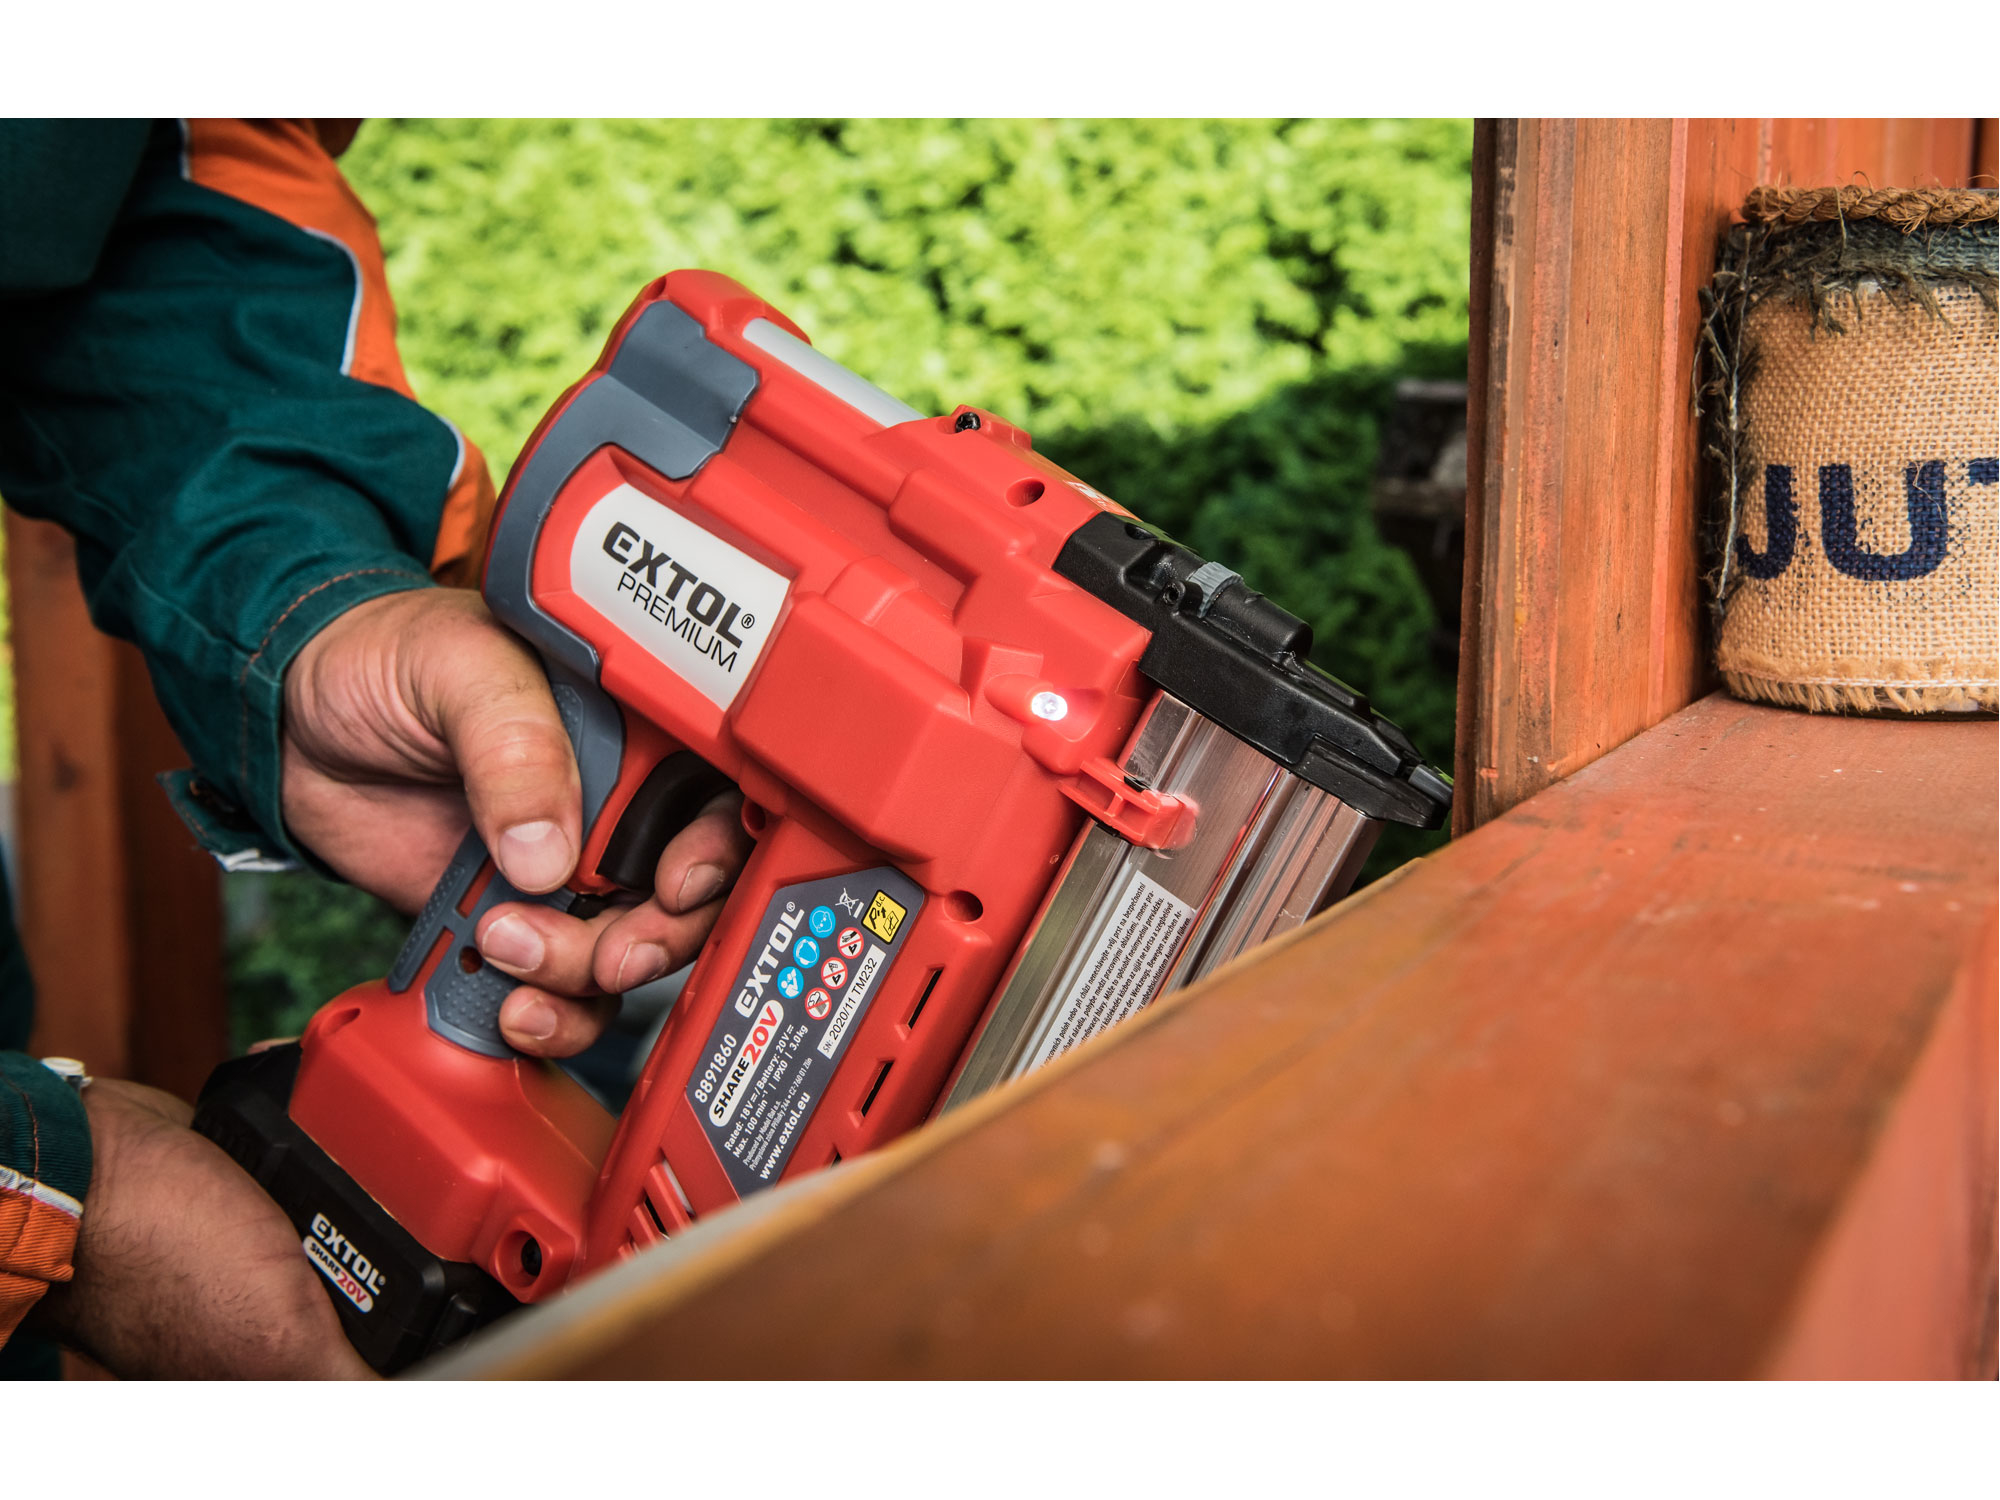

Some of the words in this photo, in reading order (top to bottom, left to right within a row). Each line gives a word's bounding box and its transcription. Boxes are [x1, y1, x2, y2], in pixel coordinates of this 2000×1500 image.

[617, 571, 743, 673] PREMIUM
[1122, 881, 1147, 920] bezpečnostní
[1112, 925, 1124, 940] prst
[1119, 917, 1127, 927] na
[1160, 917, 1179, 945] zwischen
[1142, 935, 1156, 953] tartsa
[1164, 934, 1182, 961] Auslösen
[1176, 916, 1192, 937] führen.
[1082, 994, 1099, 1018] pohybe
[1093, 977, 1107, 997] medzi
[1135, 901, 1149, 922] zmene
[1139, 951, 1147, 961] ne
[1146, 942, 1166, 969] Bewegen
[1117, 977, 1133, 999] közben
[1128, 971, 1137, 980] az
[1129, 967, 1153, 999] Werkzeugs,
[822, 1039, 834, 1053] SN:
[828, 996, 857, 1041] 2020/11
[851, 956, 878, 997] TM232
[1094, 999, 1109, 1018] hlavy.
[1111, 978, 1120, 987] to
[1125, 996, 1135, 1008] des
[1058, 1020, 1072, 1039] poloh
[1066, 1006, 1079, 1023] nebo
[693, 1032, 738, 1104] 8891860
[723, 1120, 745, 1151] Rated:
[732, 1135, 749, 1158] Max.
[744, 1116, 759, 1135] 100
[742, 1139, 760, 1166] Produced
[755, 1133, 765, 1143] by
[758, 1091, 811, 1180] www.extol.eu
